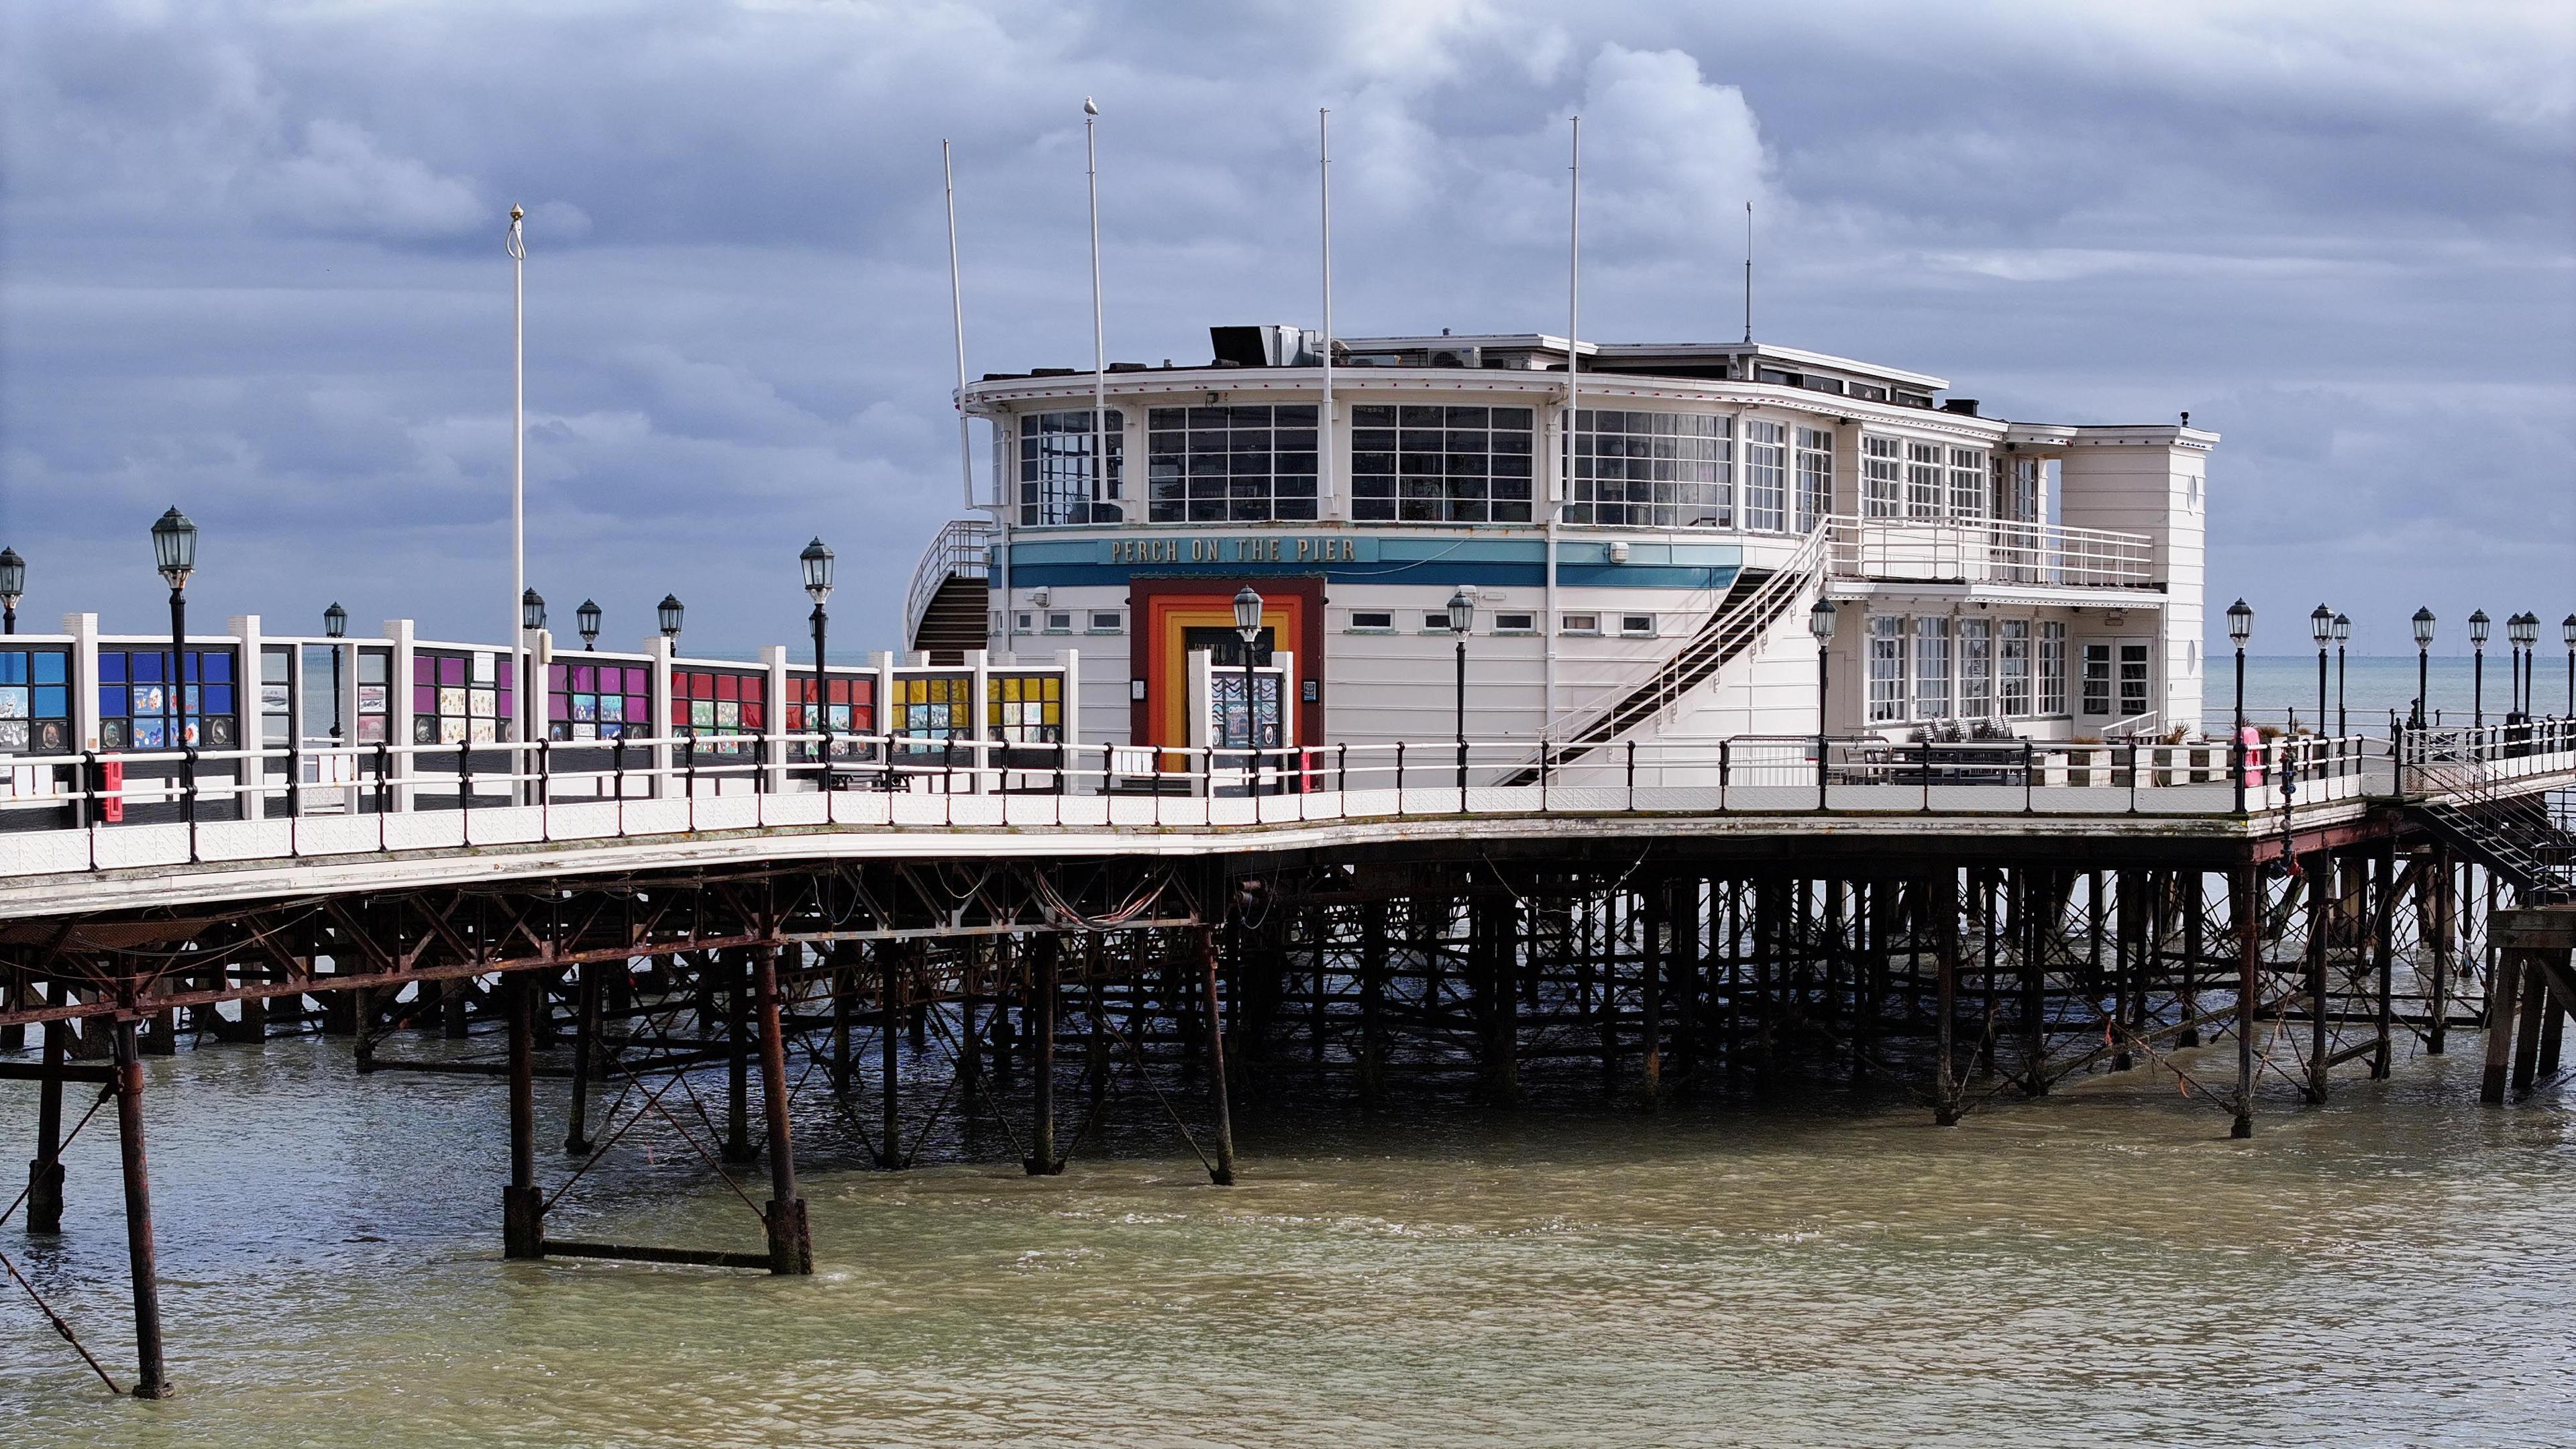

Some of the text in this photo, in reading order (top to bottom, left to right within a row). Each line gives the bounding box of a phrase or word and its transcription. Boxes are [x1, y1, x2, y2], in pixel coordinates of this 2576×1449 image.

[1112, 539, 1355, 562] PERCH ON THE PIER
